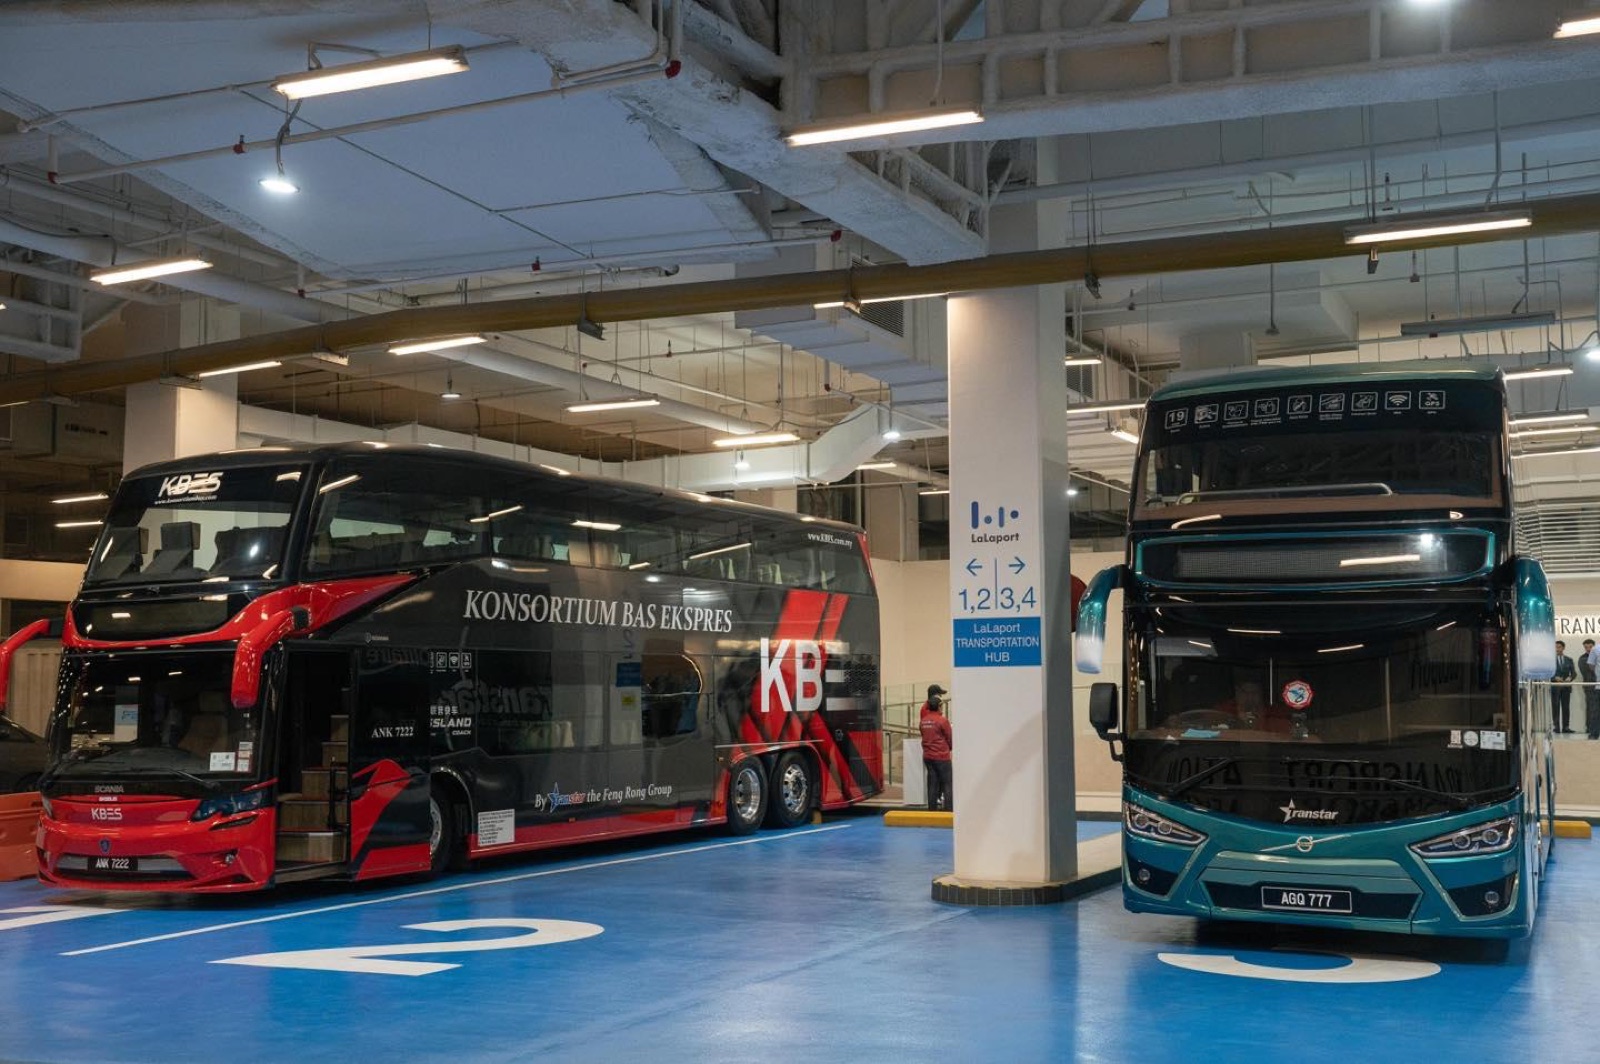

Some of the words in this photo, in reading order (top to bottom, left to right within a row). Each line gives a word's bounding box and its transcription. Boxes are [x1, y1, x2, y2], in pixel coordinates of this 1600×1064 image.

[1170, 409, 1185, 422] 19
[971, 533, 1019, 544] LaLaport
[958, 588, 991, 613] 1,2
[1000, 586, 1036, 612] 3,4
[463, 590, 618, 626] KONSORTIUM
[622, 602, 656, 628] BAS
[660, 604, 732, 633] EKSPRES
[974, 623, 1020, 635] LaLaport
[1554, 617, 1600, 634] RAN
[956, 637, 1039, 648] TRANSPORTATION
[985, 652, 1010, 663] HUB
[371, 727, 393, 738] ANK
[395, 726, 414, 737] 7222
[534, 793, 548, 811] By
[587, 789, 601, 802] the
[603, 788, 623, 803] Feng
[625, 786, 646, 800] Rong
[648, 784, 672, 797] Group
[91, 807, 123, 820] KBES
[1280, 798, 1338, 823] Transtar
[95, 858, 110, 869] ANK
[111, 858, 130, 869] 7222
[1281, 892, 1305, 905] AGQ
[1308, 893, 1332, 907] 777
[207, 918, 605, 976] 2
